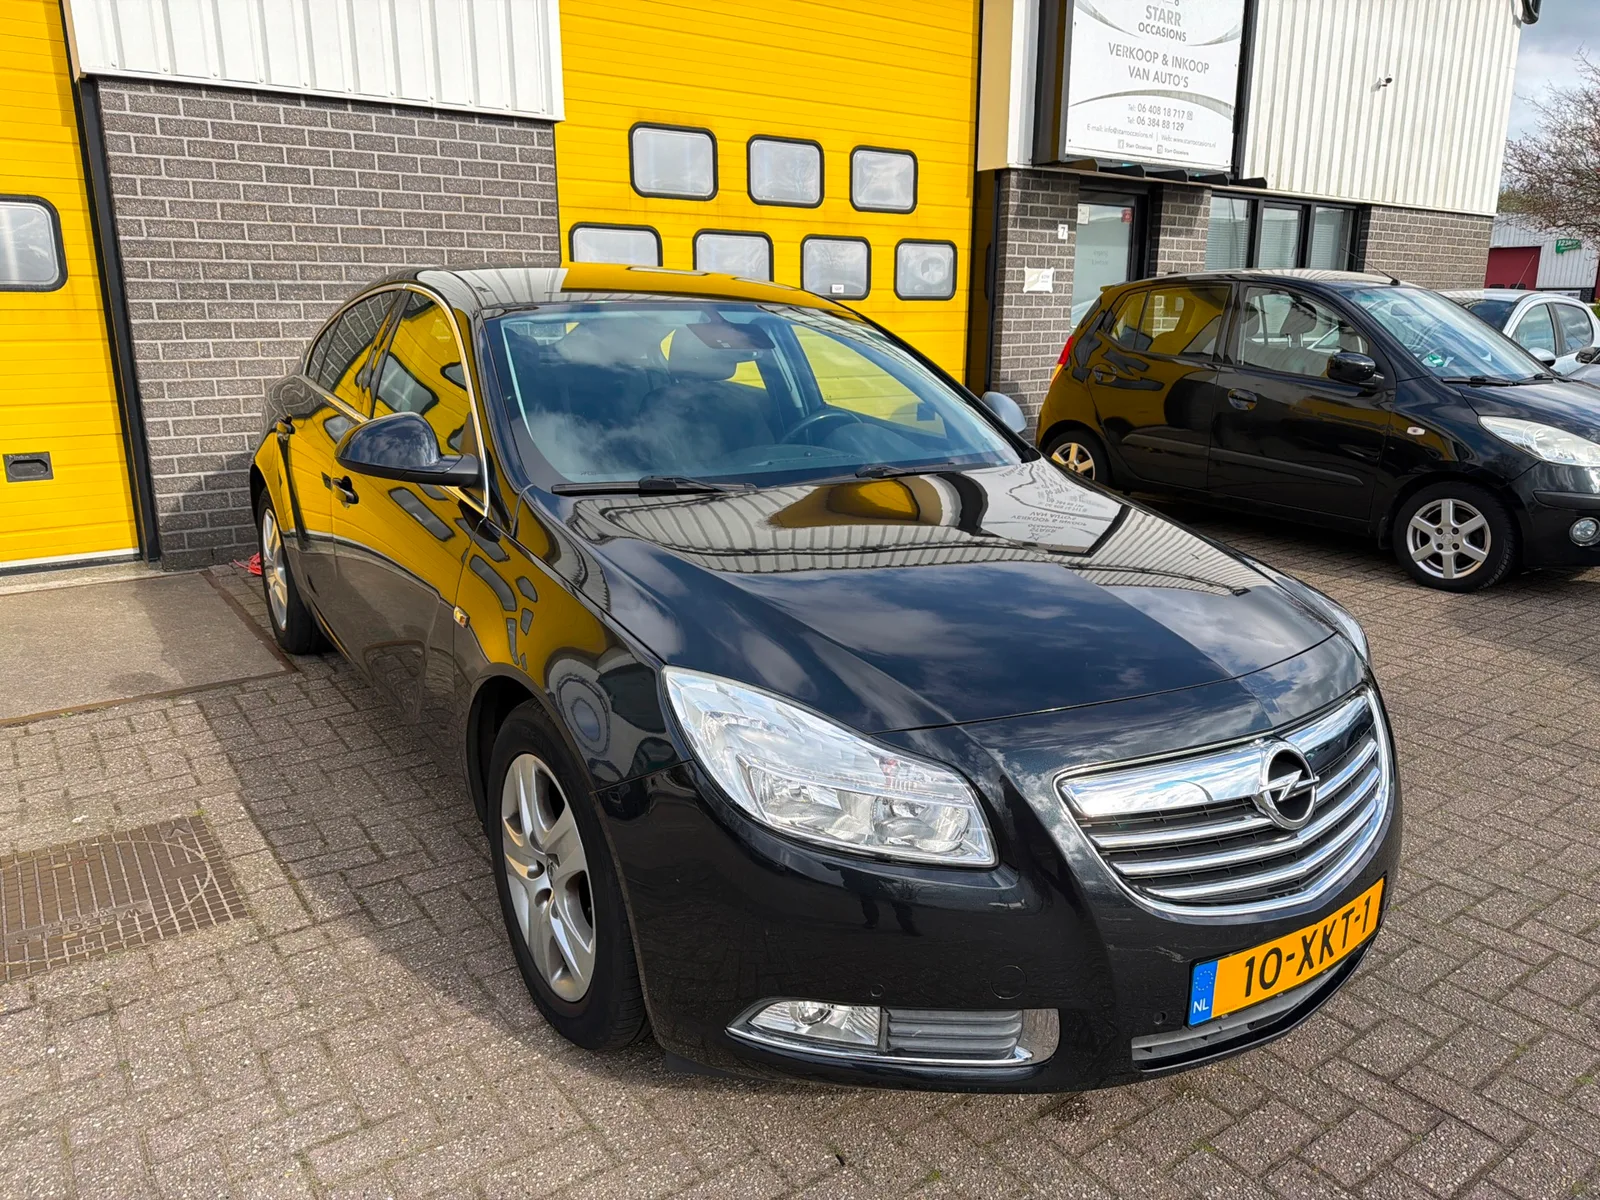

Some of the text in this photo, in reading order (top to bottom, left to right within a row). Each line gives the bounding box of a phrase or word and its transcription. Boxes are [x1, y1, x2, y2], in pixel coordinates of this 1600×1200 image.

[1145, 5, 1182, 27] STARR
[1138, 23, 1187, 42] OCCASIONS
[1108, 43, 1210, 74] VERKOOP & INKOOP
[1128, 65, 1189, 88] VAN AUTO'S
[1137, 103, 1147, 113] 06
[1148, 104, 1161, 115] 408
[1163, 107, 1171, 117] 18
[1173, 109, 1185, 119] 717
[1136, 116, 1146, 126] 06
[1148, 117, 1160, 128] 384
[1161, 119, 1170, 129] 88
[1172, 121, 1184, 131] 129
[1061, 226, 1066, 237] 7
[1244, 896, 1371, 998] 10-XKT-1
[1192, 998, 1210, 1014] NL
